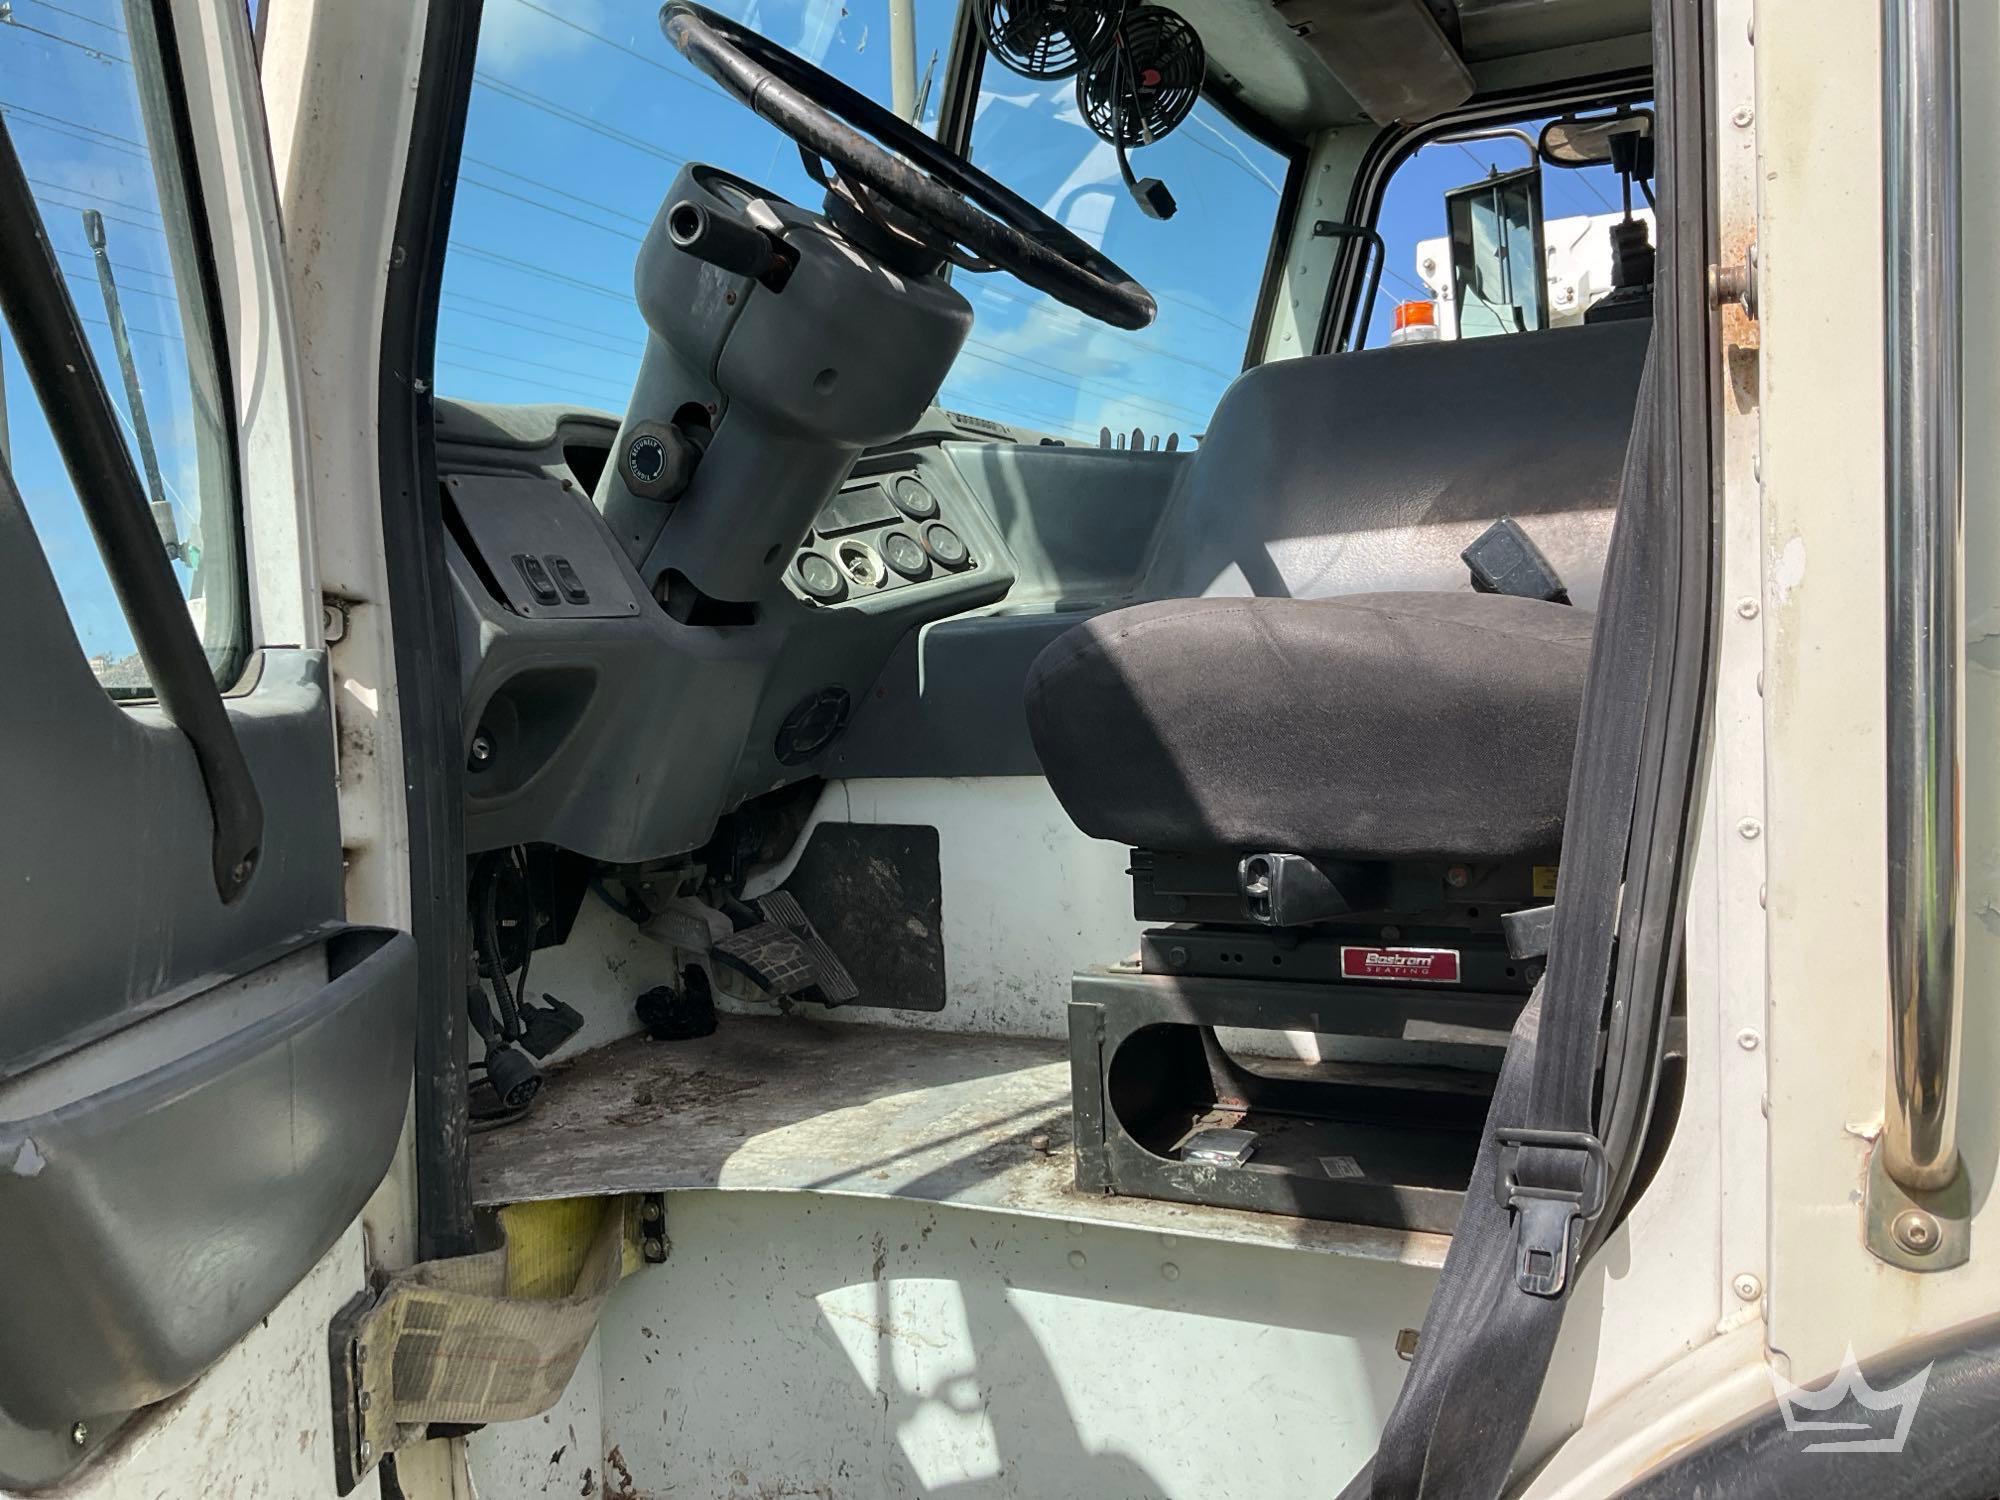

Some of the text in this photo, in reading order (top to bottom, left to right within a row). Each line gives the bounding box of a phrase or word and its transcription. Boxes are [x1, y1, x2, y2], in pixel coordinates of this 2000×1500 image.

[632, 440, 658, 480] TIGHTEN SECURELY
[1366, 967, 1429, 975] SEATING
